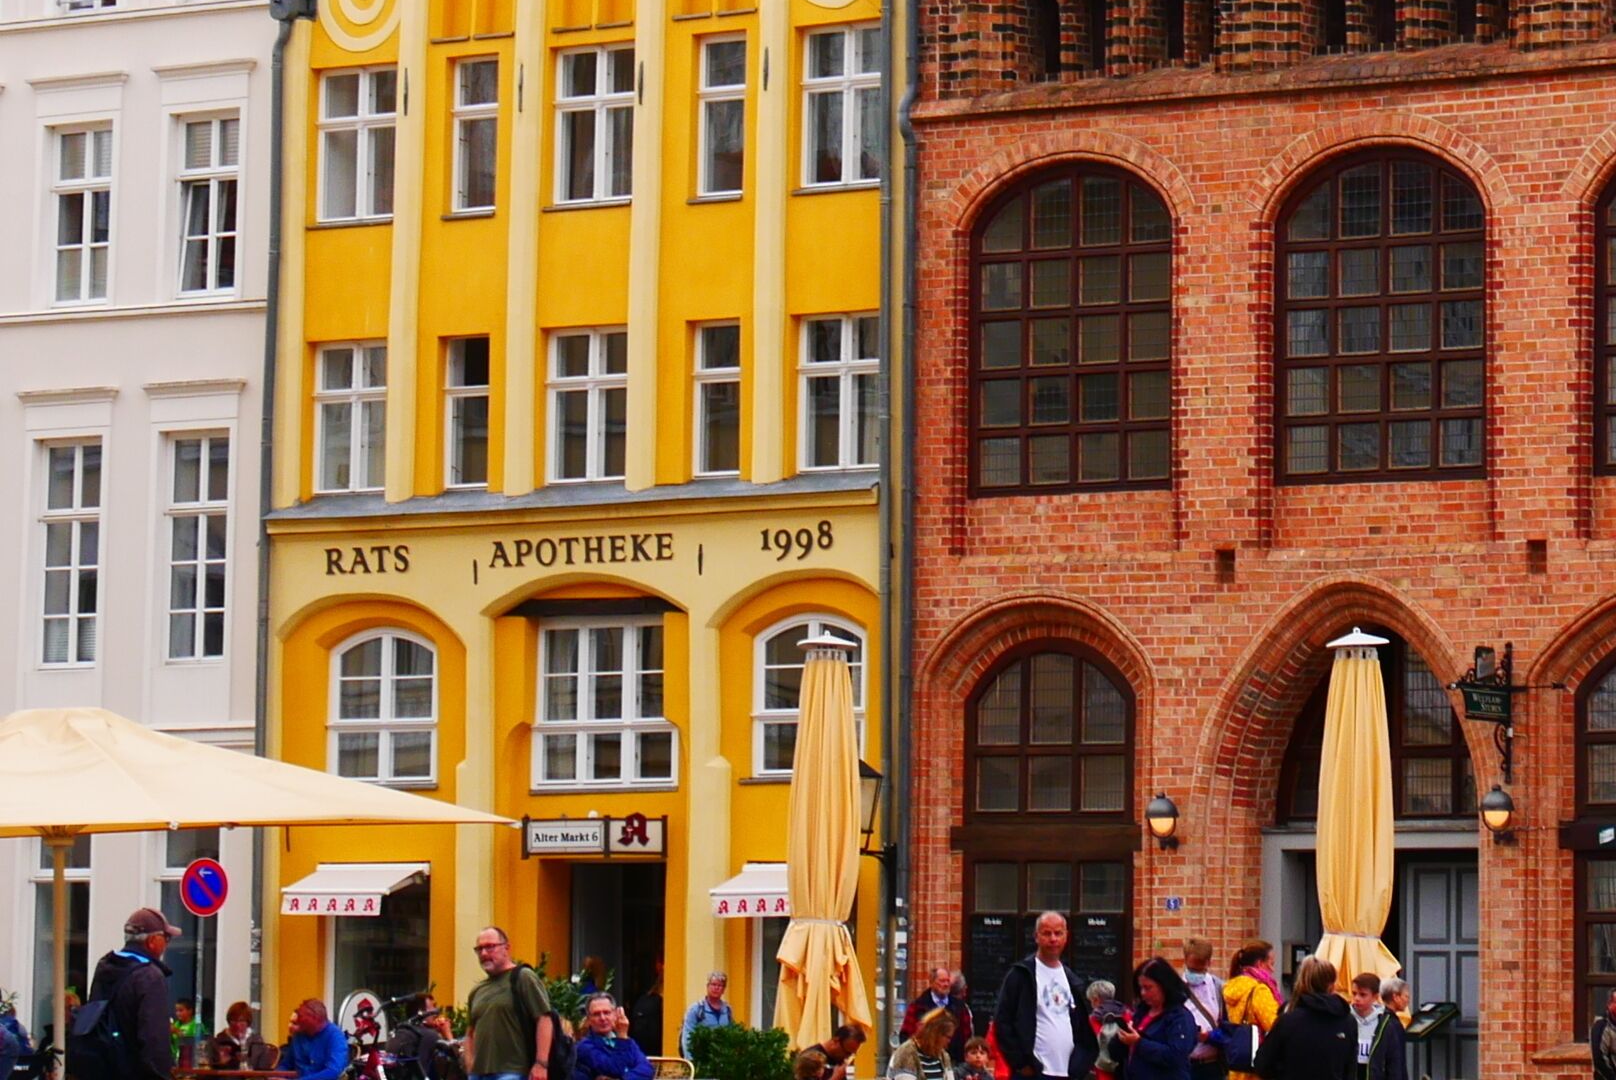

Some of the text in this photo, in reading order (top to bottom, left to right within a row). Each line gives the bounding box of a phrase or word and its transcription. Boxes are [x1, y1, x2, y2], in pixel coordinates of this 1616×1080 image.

[324, 520, 834, 575] RATS APOTHEKE 1998
[534, 831, 599, 843] Alter Markt 6
